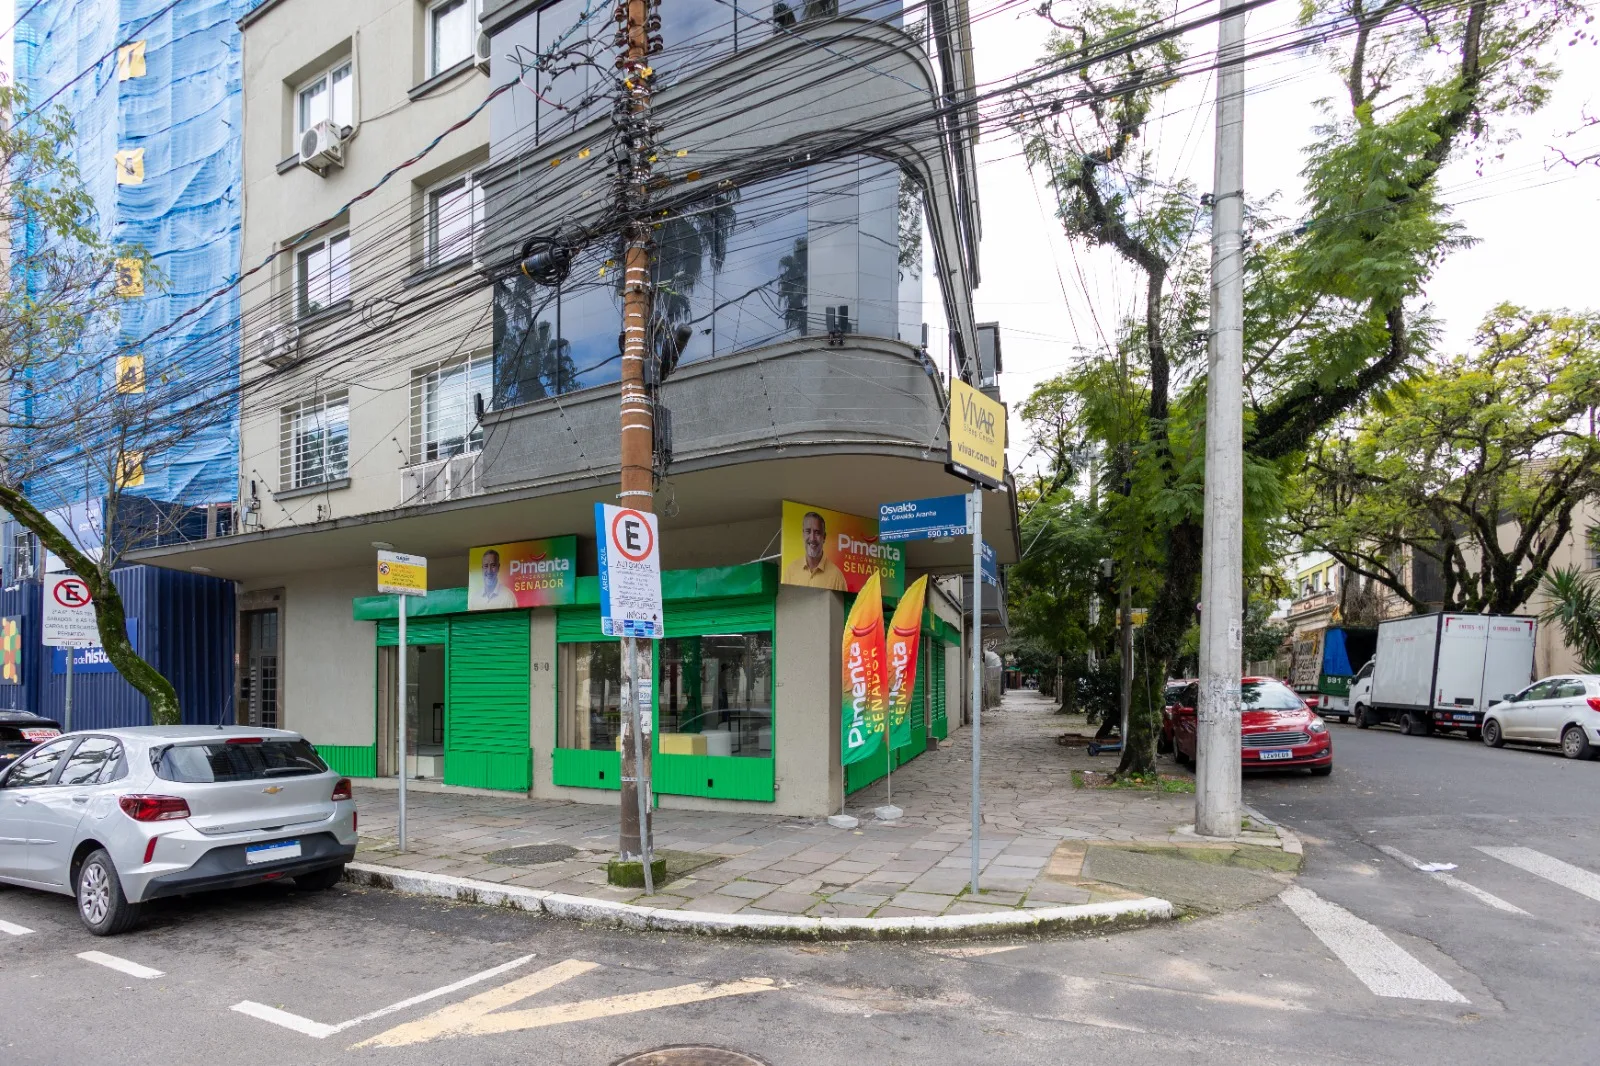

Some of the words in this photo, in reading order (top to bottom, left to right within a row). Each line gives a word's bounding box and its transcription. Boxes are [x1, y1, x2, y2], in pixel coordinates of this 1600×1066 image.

[960, 392, 995, 438] VIVAR
[957, 442, 998, 468] vivar.com.br
[880, 502, 917, 514] Osvaldo
[625, 520, 641, 551] E
[927, 529, 942, 538] 590
[950, 527, 965, 536] 500
[837, 533, 901, 561] Pimenta
[509, 557, 570, 576] Pimenta
[66, 585, 79, 601] E
[514, 578, 564, 592] SENADOR
[848, 641, 867, 748] Pimenta
[871, 646, 885, 733] SENADOR
